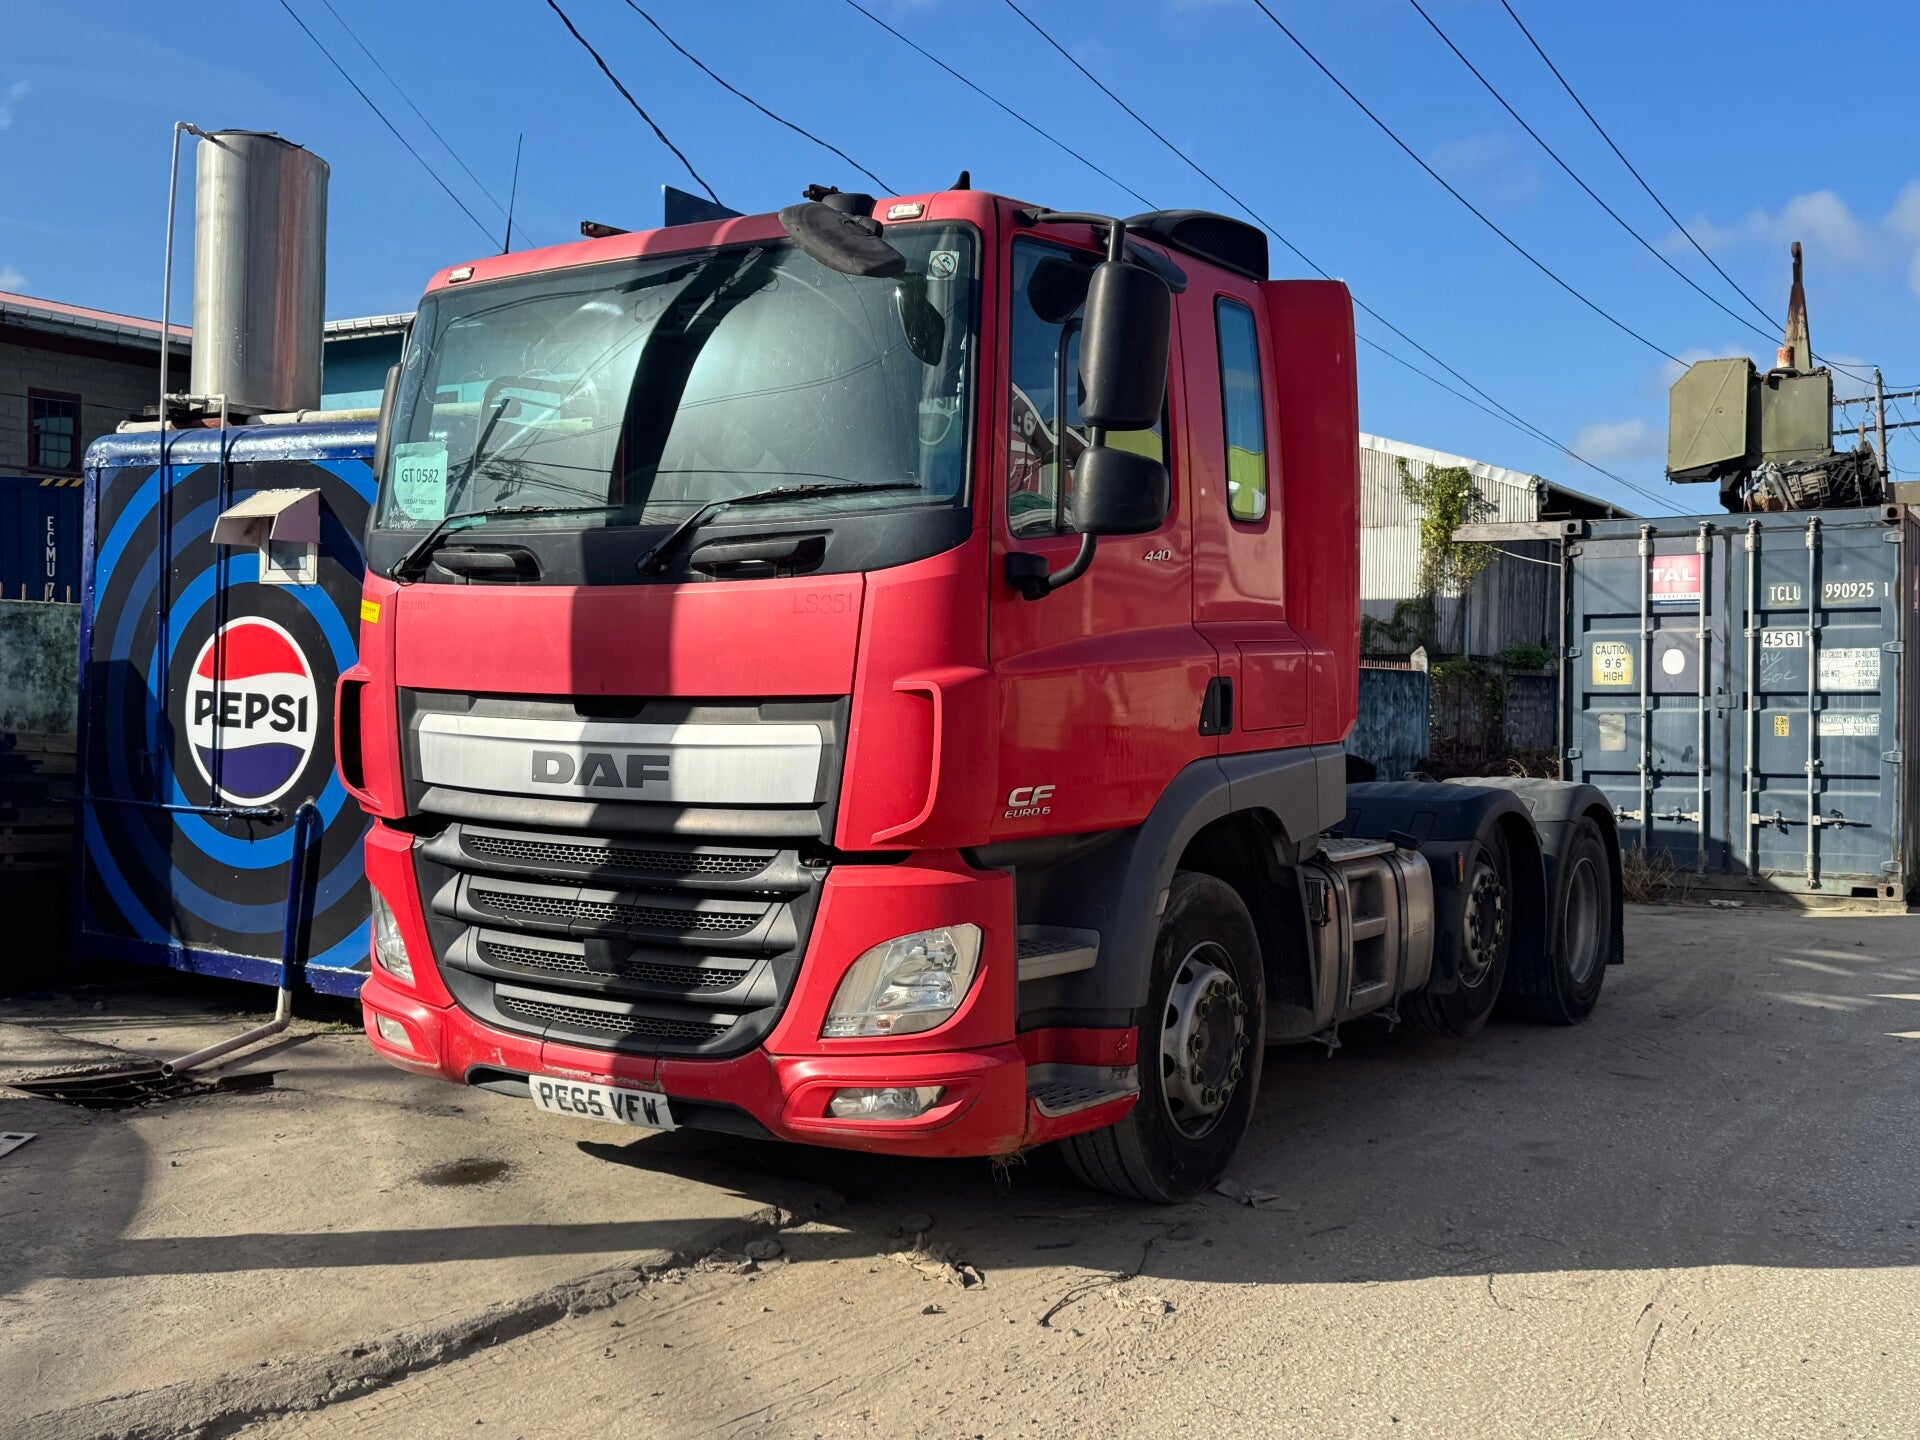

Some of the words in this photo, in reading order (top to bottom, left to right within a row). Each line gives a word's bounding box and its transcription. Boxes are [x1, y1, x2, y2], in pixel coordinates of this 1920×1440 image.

[401, 468, 414, 483] GT
[416, 468, 439, 483] 0582
[45, 515, 56, 578] ECMU
[1143, 549, 1171, 561] 440
[1648, 567, 1698, 583] TAL
[1769, 585, 1801, 601] TCLU
[1825, 582, 1875, 599] 990925
[1883, 581, 1889, 597] 1
[1763, 632, 1801, 647] 45G1
[1595, 645, 1632, 655] CAUTION
[1603, 671, 1624, 682] HIGH
[194, 689, 309, 733] PEPSI
[531, 750, 670, 788] DAF
[1008, 784, 1056, 807] CF
[1004, 807, 1041, 819] EURO
[1041, 806, 1051, 815] 6
[538, 1081, 605, 1117] PE65
[608, 1091, 661, 1126] VFW
